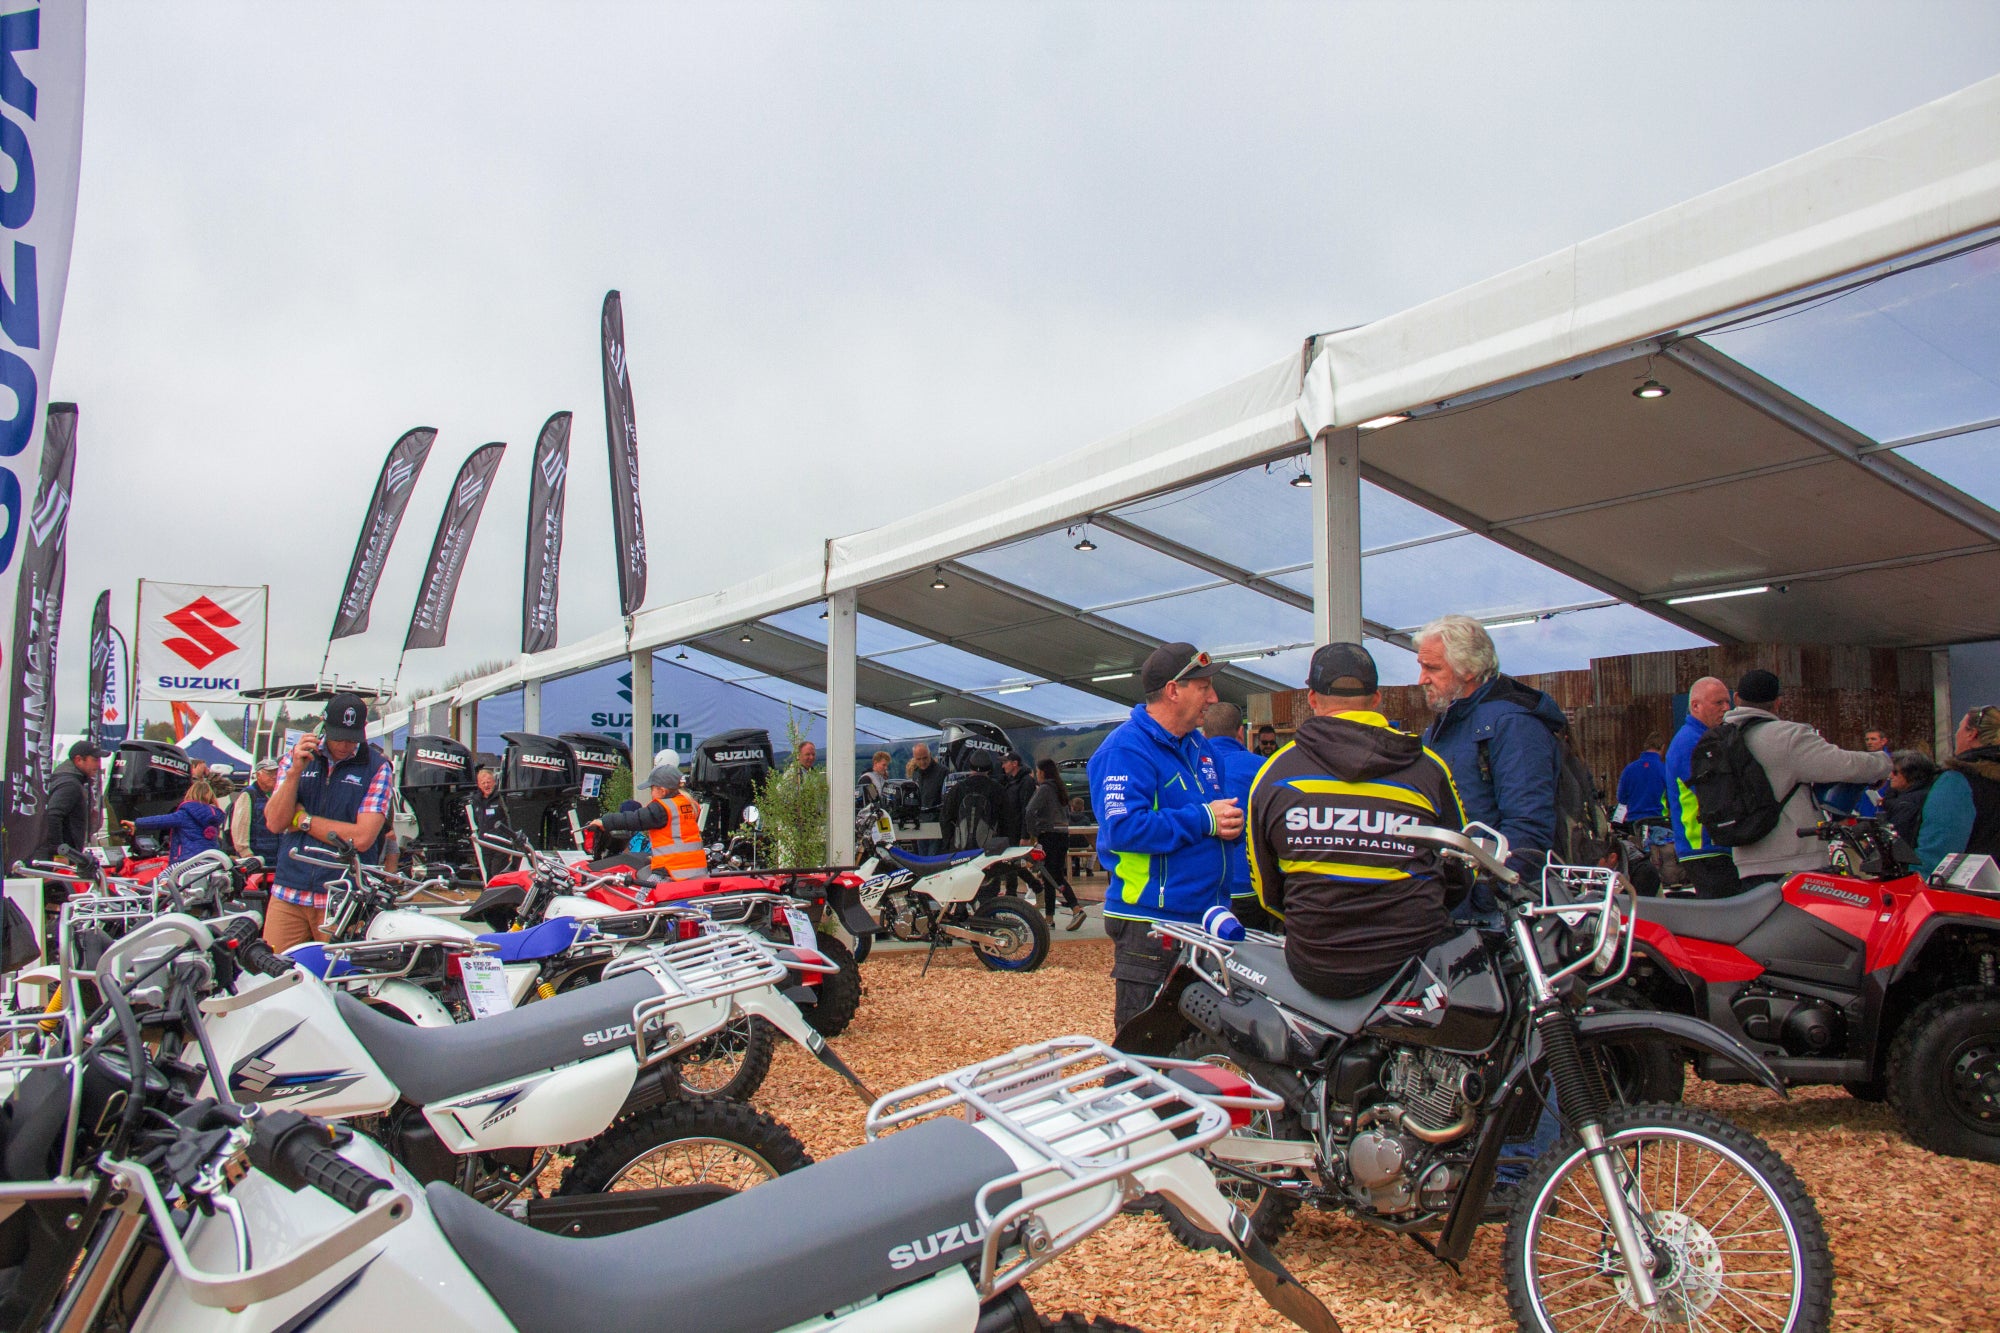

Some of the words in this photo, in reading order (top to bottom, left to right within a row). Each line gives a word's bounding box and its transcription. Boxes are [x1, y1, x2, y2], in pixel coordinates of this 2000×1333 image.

[345, 508, 388, 618] ULTIMATE
[420, 523, 460, 629] ULTIMATE
[158, 676, 240, 690] SUZUKI
[591, 713, 679, 728] SUZKI
[965, 739, 1009, 754] SUZUKI
[151, 754, 189, 773] SUZUKI
[417, 748, 466, 765] SUZUKI
[522, 754, 566, 767] SUZUKI
[714, 749, 764, 762] SUZUKI
[10, 771, 24, 814] THE
[1286, 836, 1356, 847] FACTORY
[1358, 838, 1416, 854] RACING
[950, 856, 971, 866] SUZUKI
[1804, 877, 1835, 888] SUZUKI
[1800, 882, 1871, 905] KINGQUAD
[1225, 958, 1268, 986] SUZUKI
[1404, 1007, 1423, 1016] DR
[272, 1085, 309, 1097] DR
[888, 1215, 1021, 1270] SUZU
